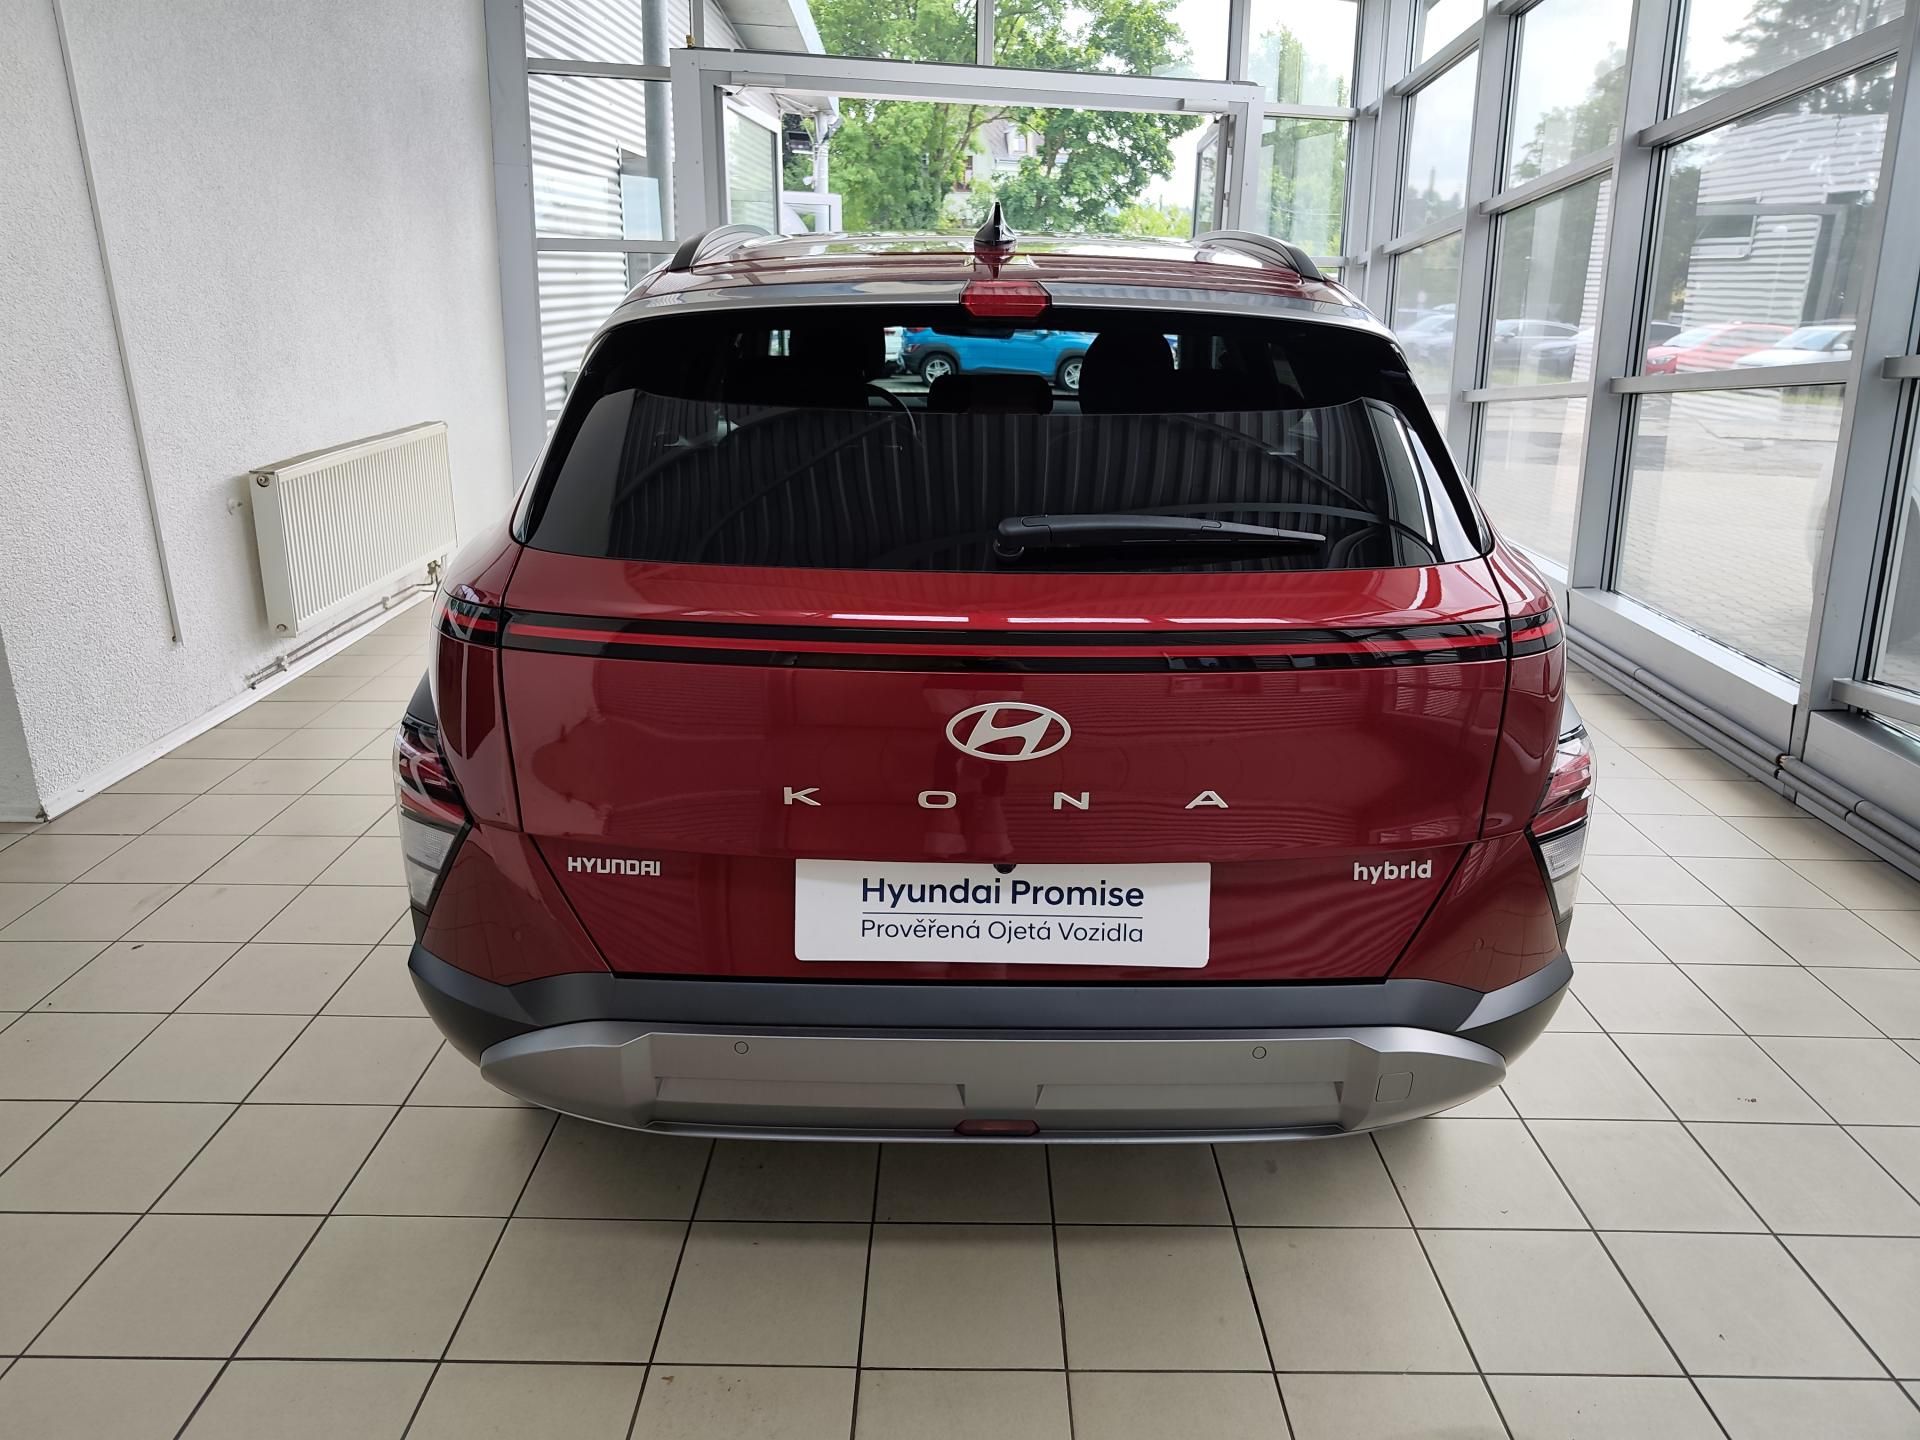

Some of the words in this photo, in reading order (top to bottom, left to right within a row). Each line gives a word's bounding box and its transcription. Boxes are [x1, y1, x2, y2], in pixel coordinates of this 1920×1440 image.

[783, 786, 1229, 811] KONA
[567, 856, 661, 877] HYUNDAI
[1353, 859, 1433, 884] hybrid
[862, 877, 1001, 908] Hyundai
[1011, 879, 1145, 907] Promise
[861, 918, 981, 941] Prověřená
[988, 920, 1052, 944] Ojetá
[1058, 921, 1144, 943] Vozidla
